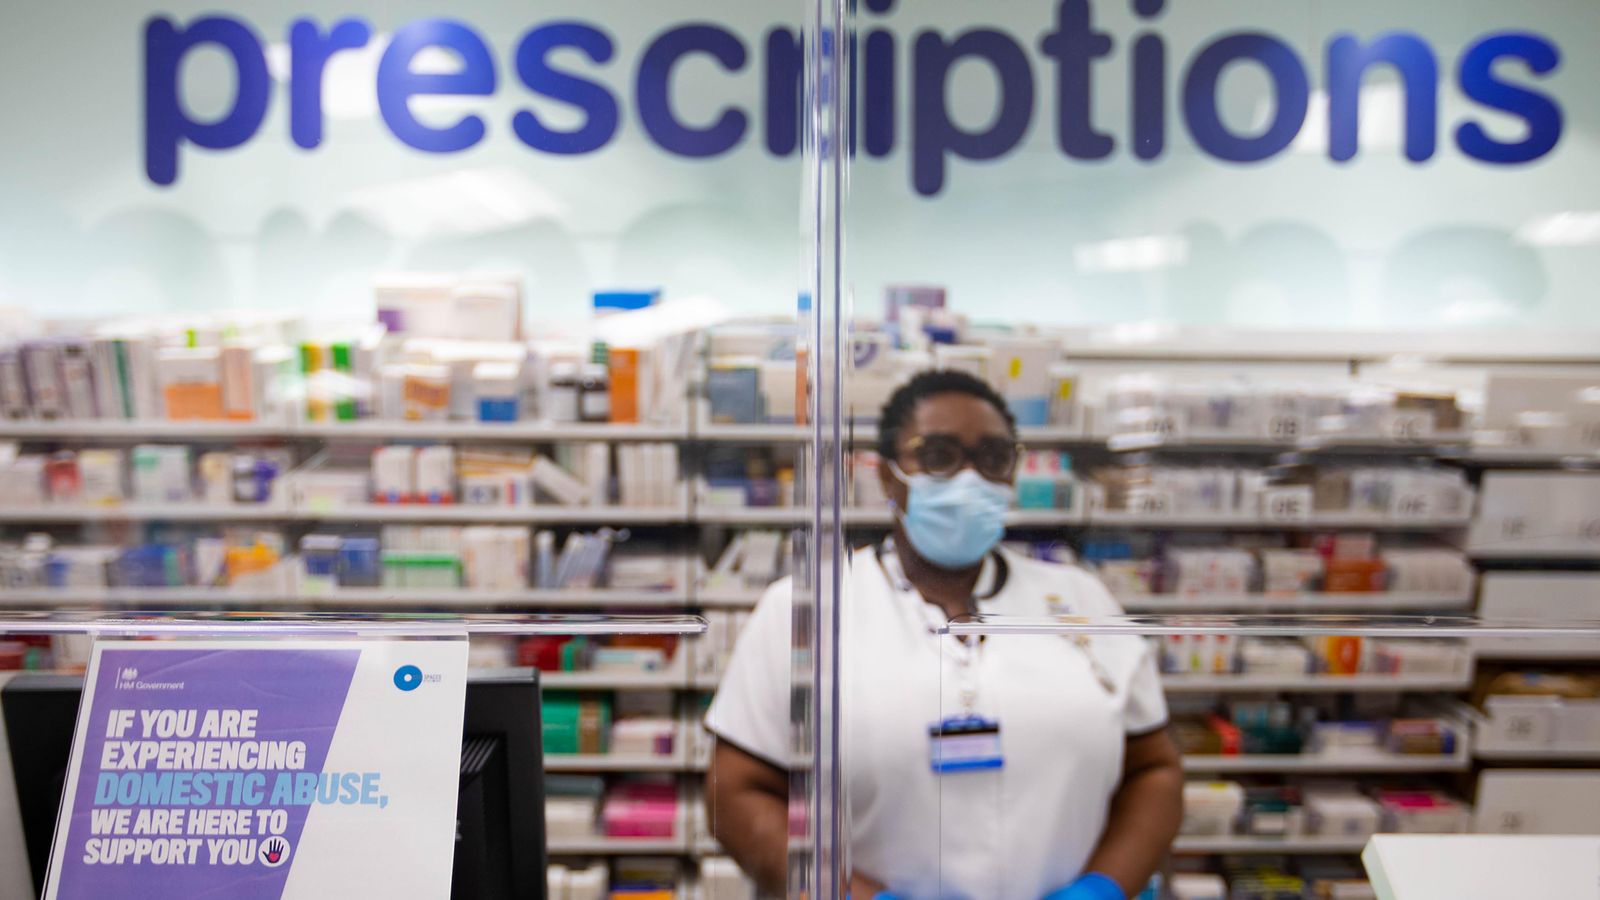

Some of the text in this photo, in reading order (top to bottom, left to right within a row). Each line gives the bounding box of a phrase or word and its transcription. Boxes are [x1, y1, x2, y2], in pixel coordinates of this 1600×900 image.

[144, 0, 1563, 197] prescriptions
[120, 681, 184, 689] HM Government
[106, 709, 258, 738] IF YOU ARE
[100, 741, 306, 770] EXPERIENCING
[94, 772, 389, 809] DOMESTIC ABUSE,
[91, 809, 288, 835] WE ARE HERE TO
[83, 838, 257, 865] SUPPORT YOU
